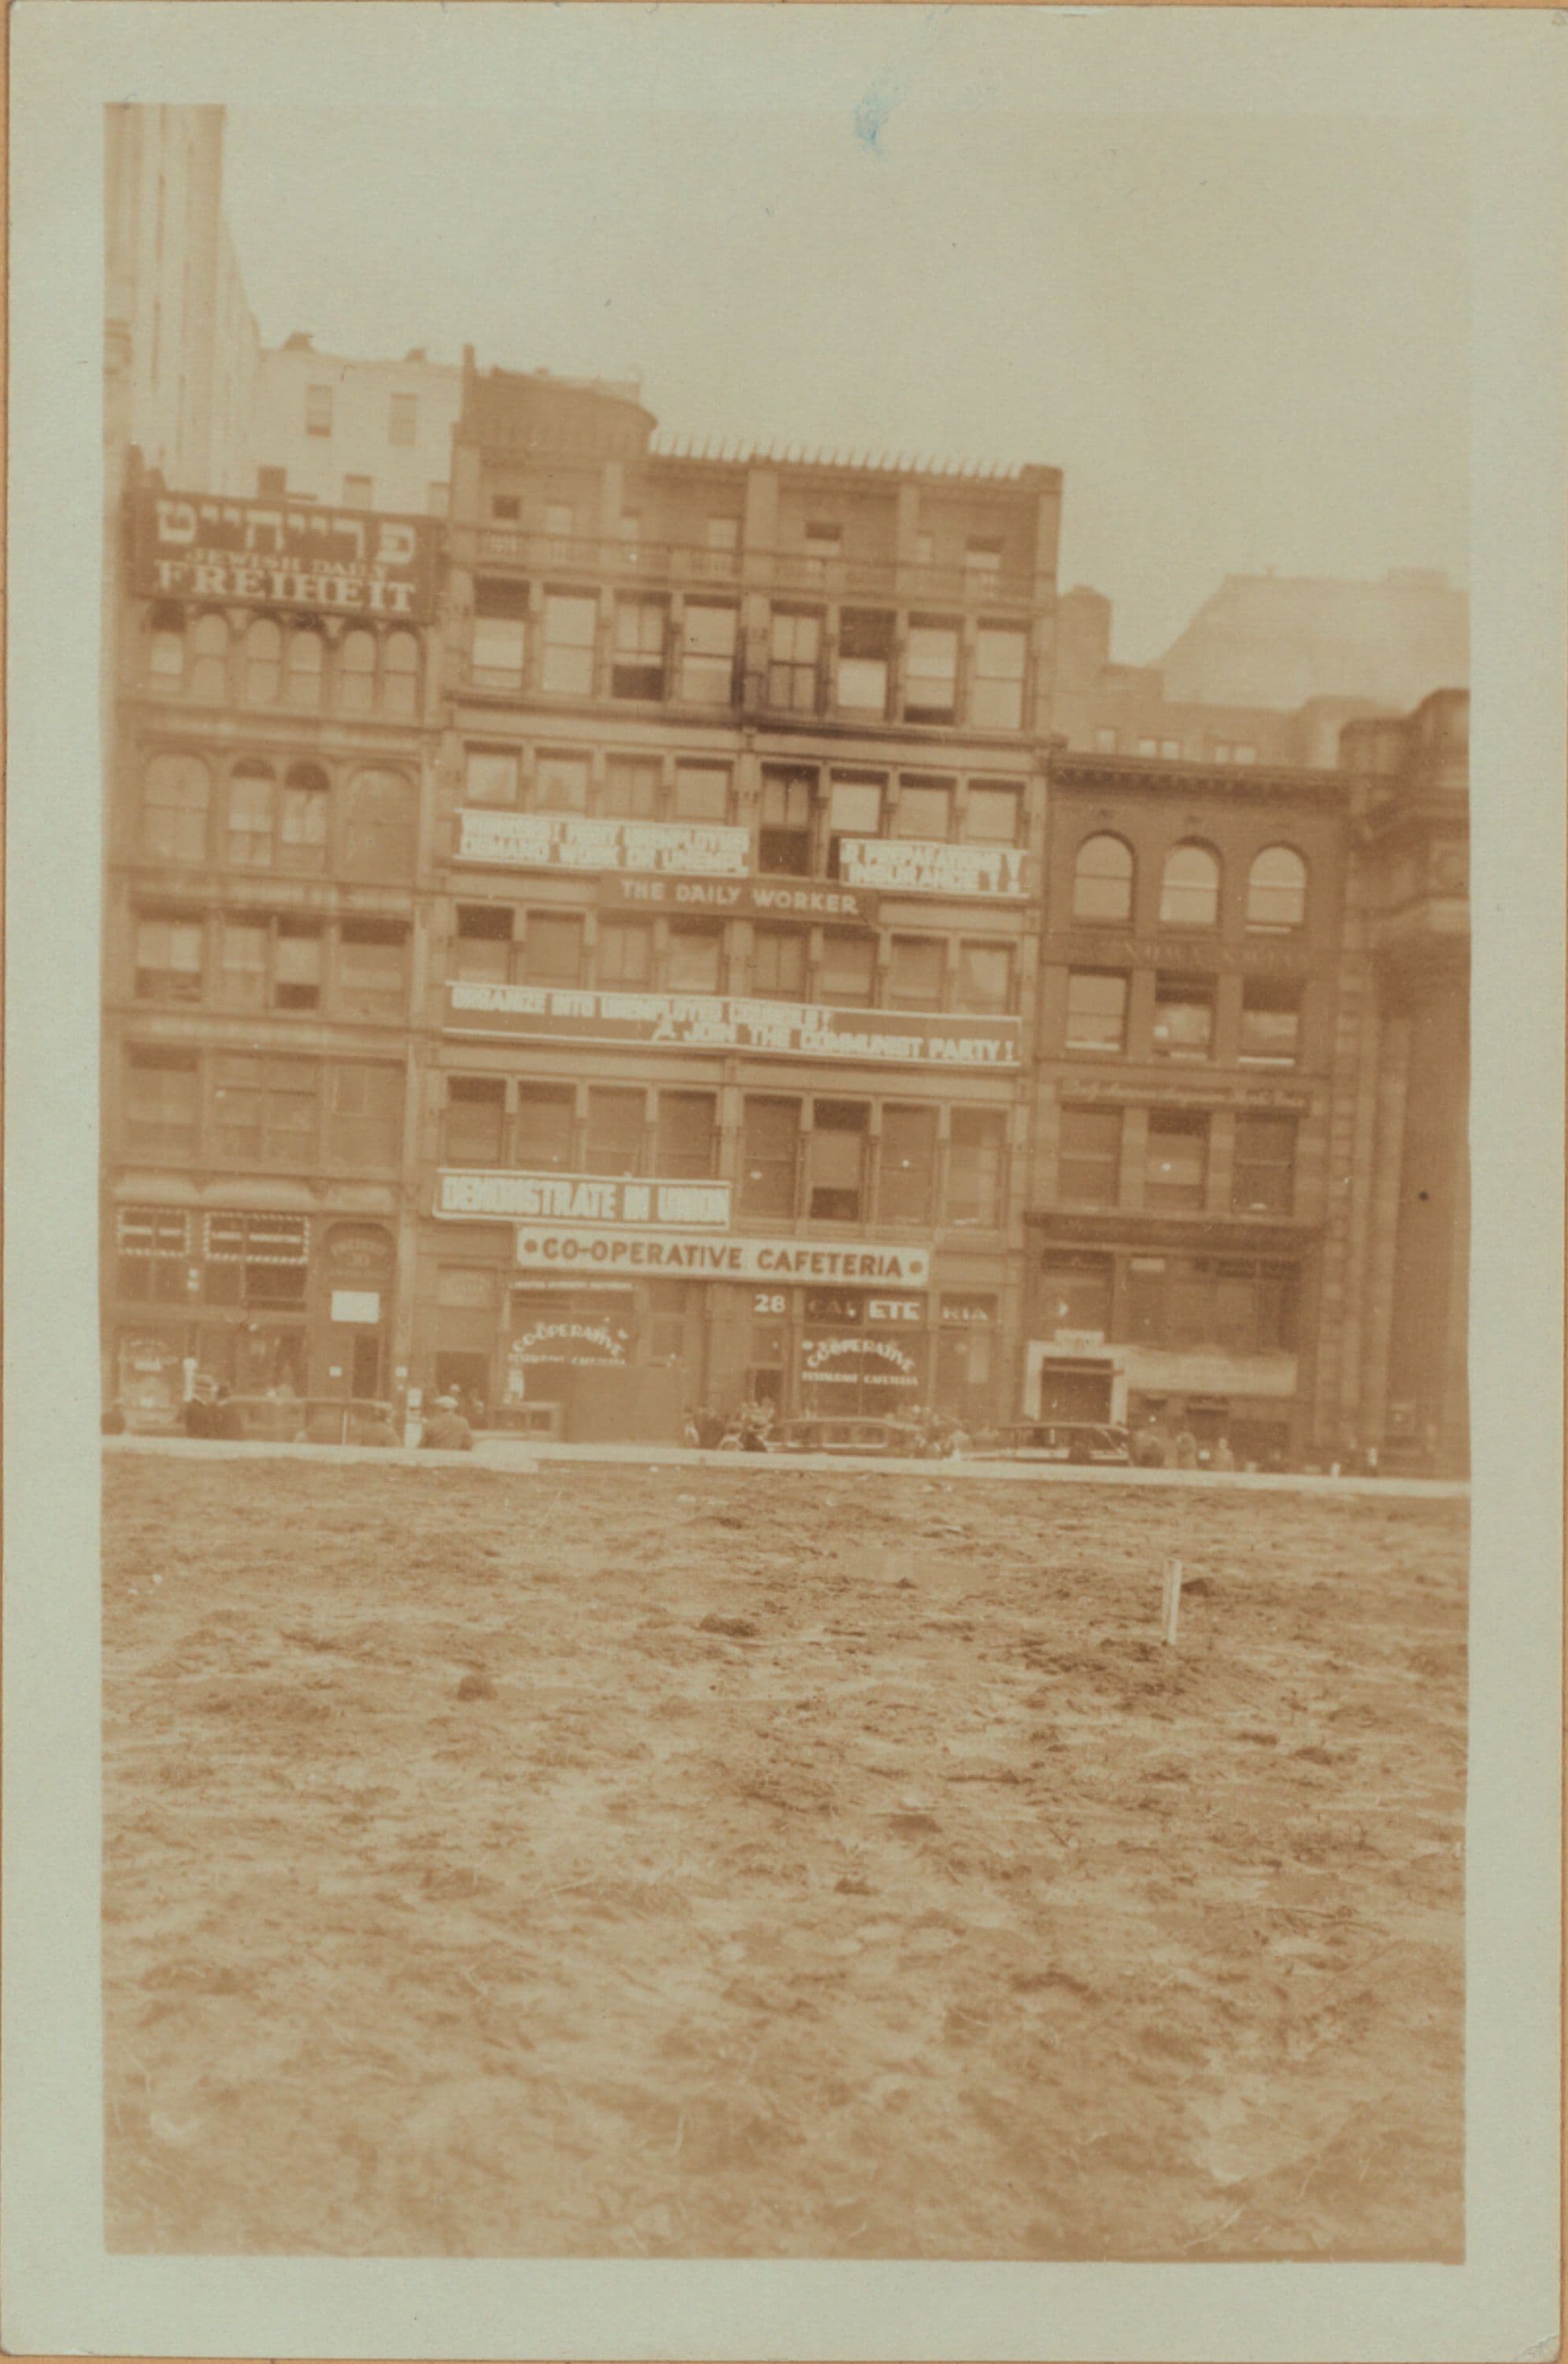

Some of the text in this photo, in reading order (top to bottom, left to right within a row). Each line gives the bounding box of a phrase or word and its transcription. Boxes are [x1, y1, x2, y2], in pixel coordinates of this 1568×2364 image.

[153, 559, 416, 612] FREIHEIT
[620, 879, 859, 915] THE DAILY WORKER
[749, 1023, 791, 1049] THE
[800, 1030, 925, 1059] COMMUNIST
[442, 1175, 617, 1219] DEMONSTRATE
[542, 1237, 903, 1278] CO-OPERATIVE CAFETERIA
[753, 1293, 786, 1314] 28
[868, 1299, 920, 1321] ETE
